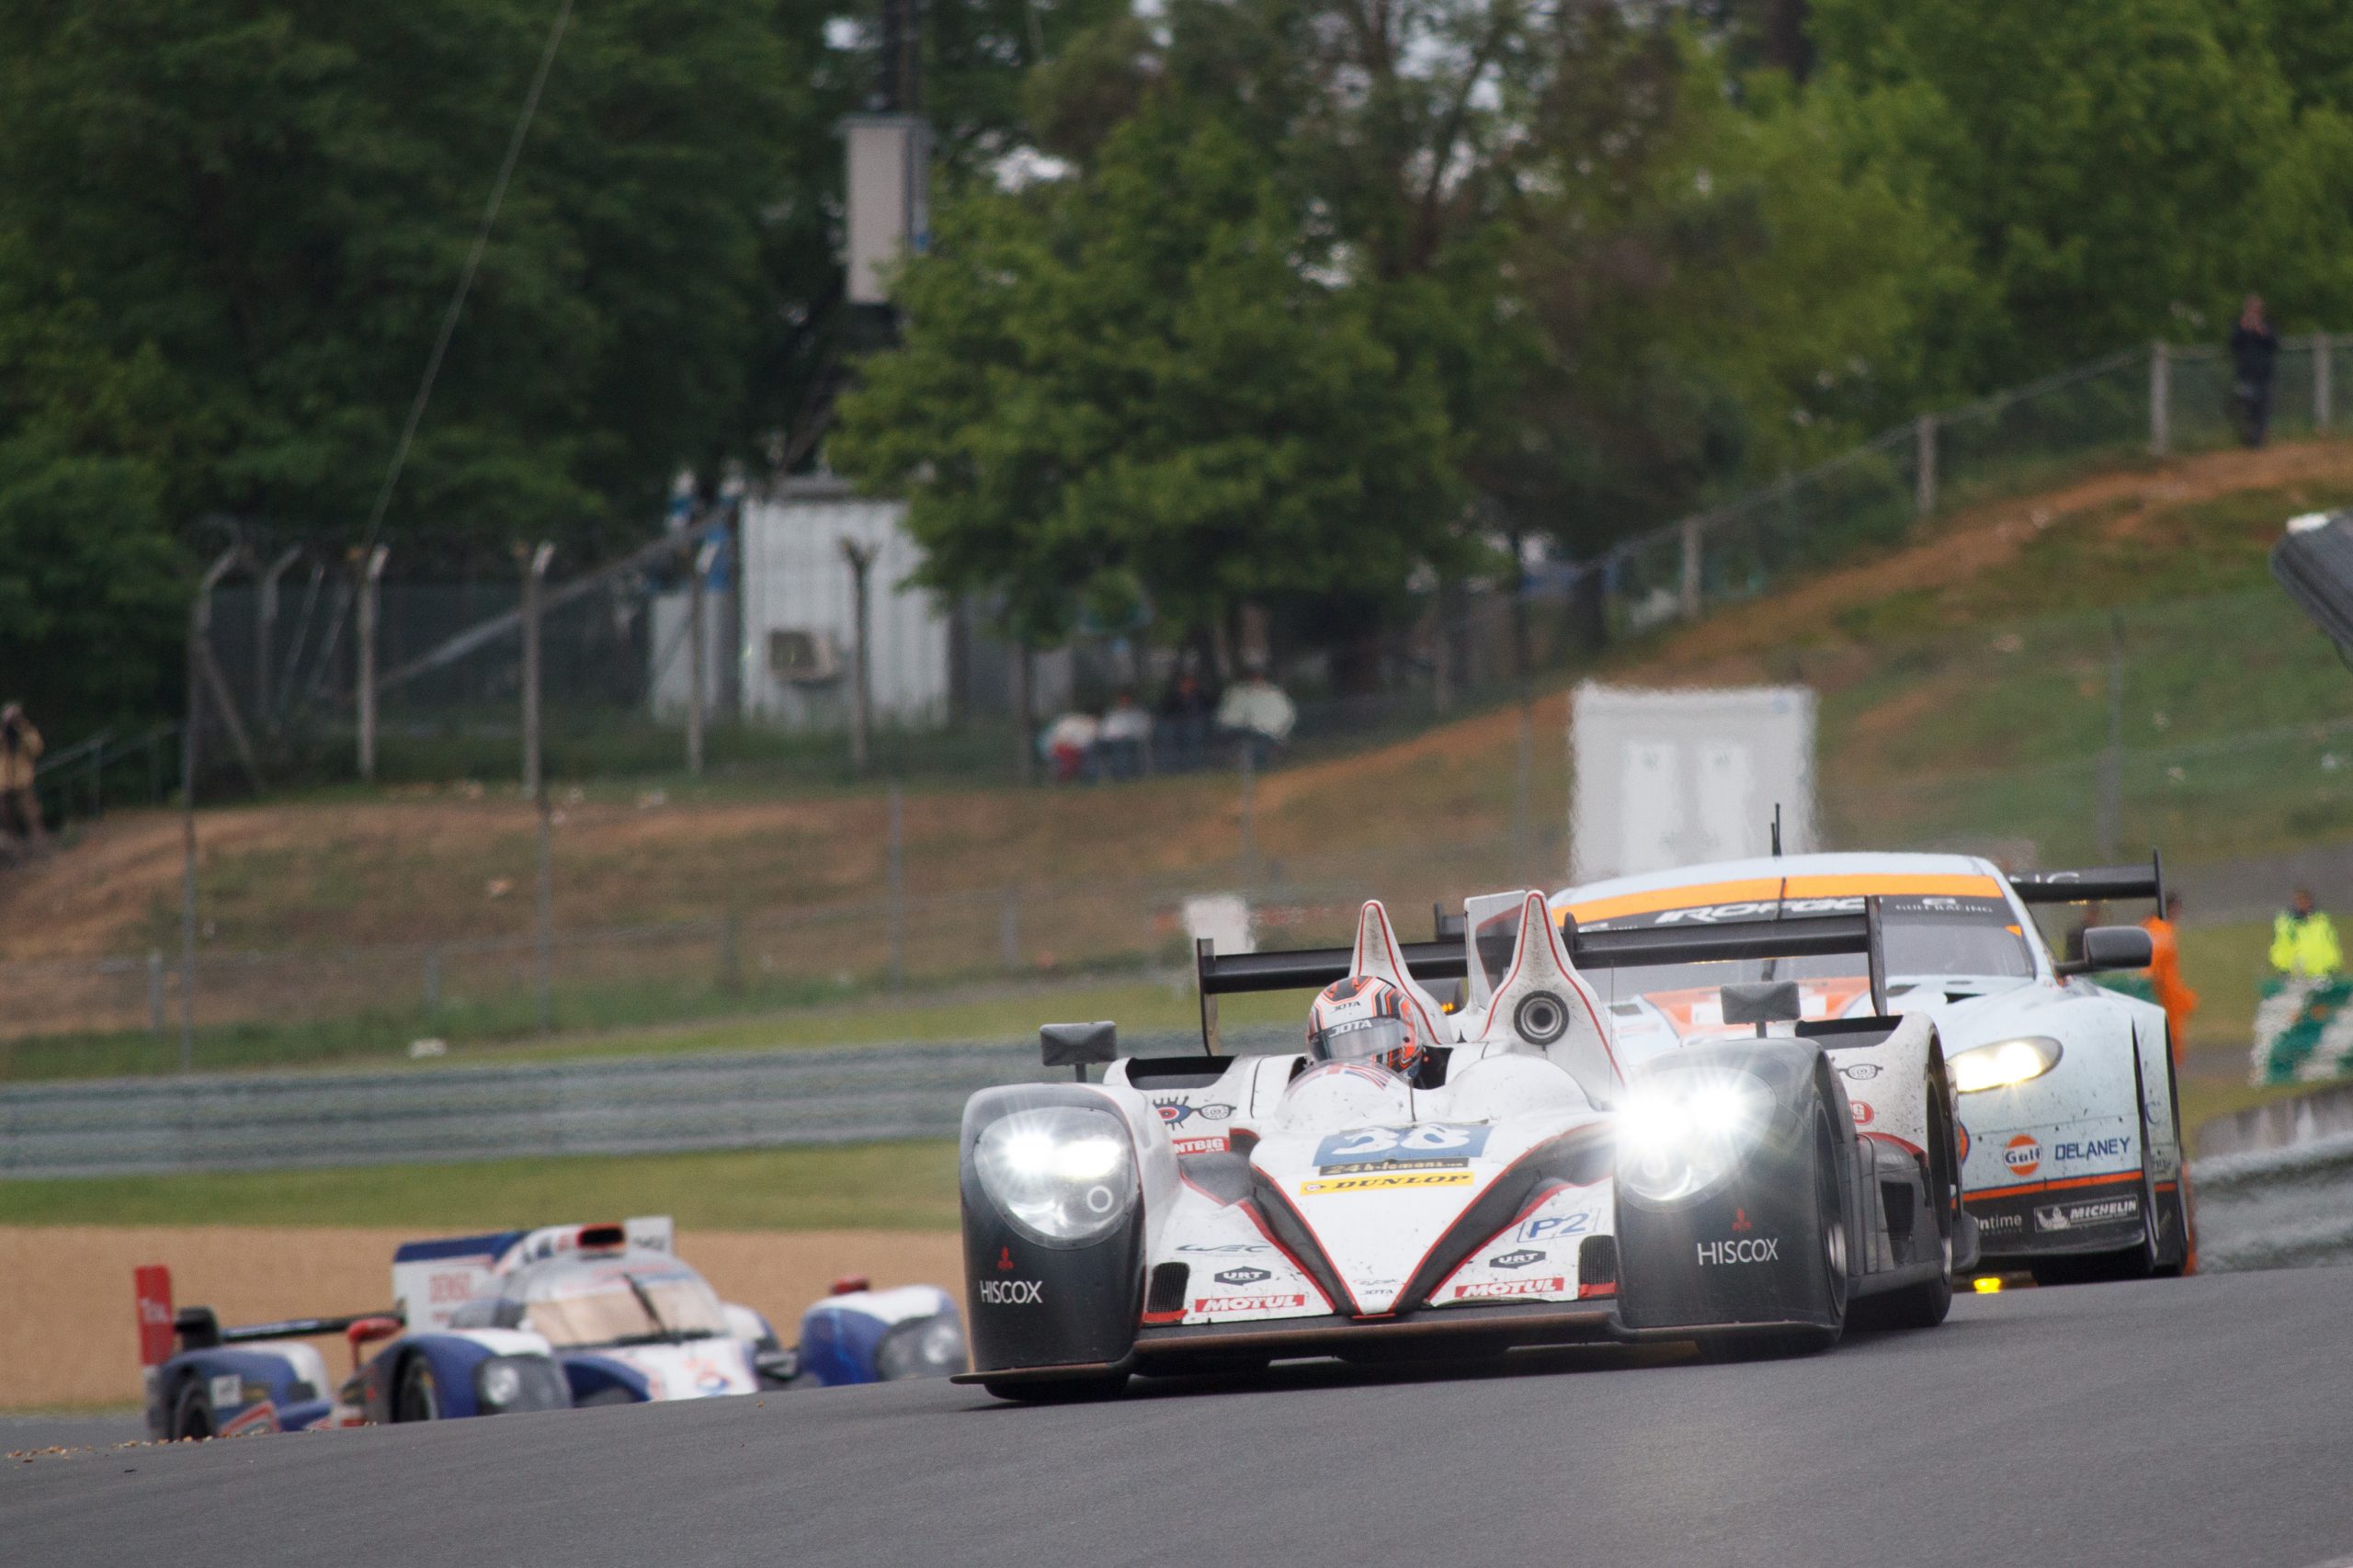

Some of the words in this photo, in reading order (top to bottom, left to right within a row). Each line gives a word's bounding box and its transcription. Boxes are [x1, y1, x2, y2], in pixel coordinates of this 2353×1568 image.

[1329, 1019, 1372, 1038] JOTA
[2005, 1148, 2041, 1165] Gulf
[2055, 1137, 2131, 1161] DELANEY
[1333, 1175, 1470, 1188] DUNLOP
[2070, 1200, 2137, 1220] MICHELIN
[1529, 1213, 1589, 1239] P2
[1975, 1214, 2022, 1231] ntime
[1697, 1238, 1779, 1266] HISCOX
[979, 1280, 1043, 1304] HISCOX
[1462, 1278, 1557, 1297] MOTUL
[1202, 1295, 1299, 1312] MOTUL
